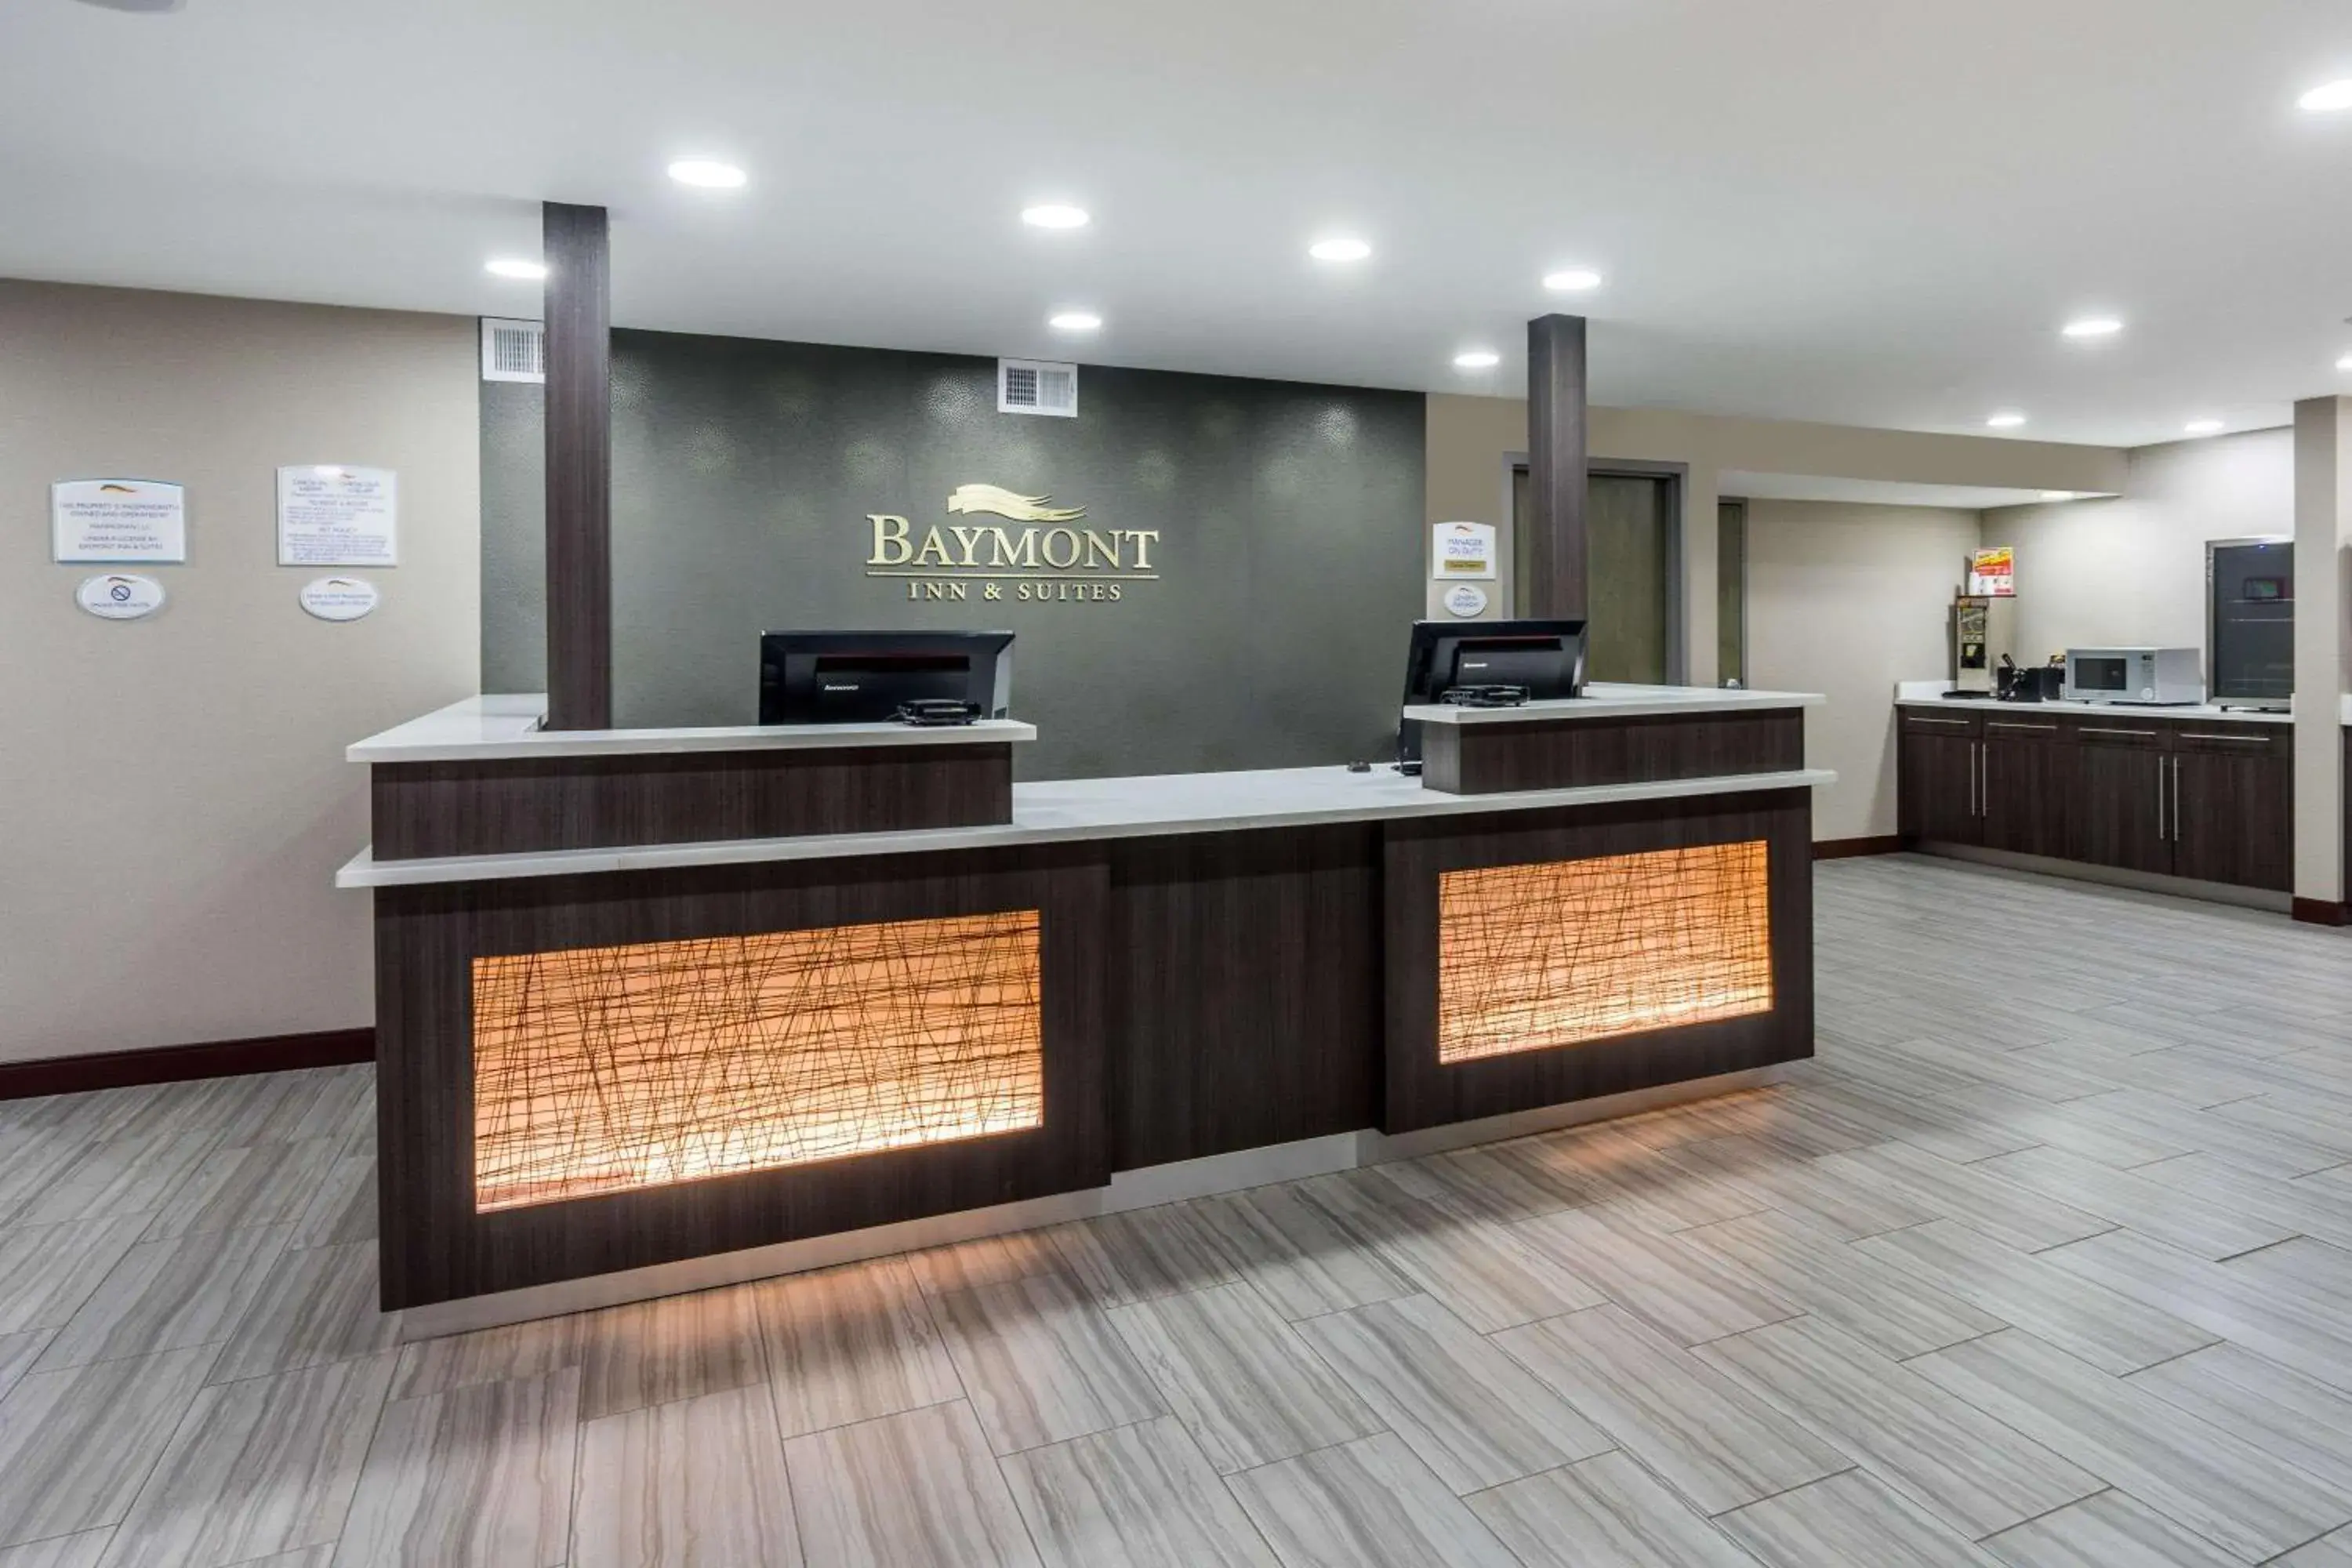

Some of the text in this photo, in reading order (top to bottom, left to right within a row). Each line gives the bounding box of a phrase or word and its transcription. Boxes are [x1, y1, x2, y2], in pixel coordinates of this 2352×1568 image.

[866, 514, 1160, 568] BAYMONT
[908, 583, 1122, 601] INN & SUITES
